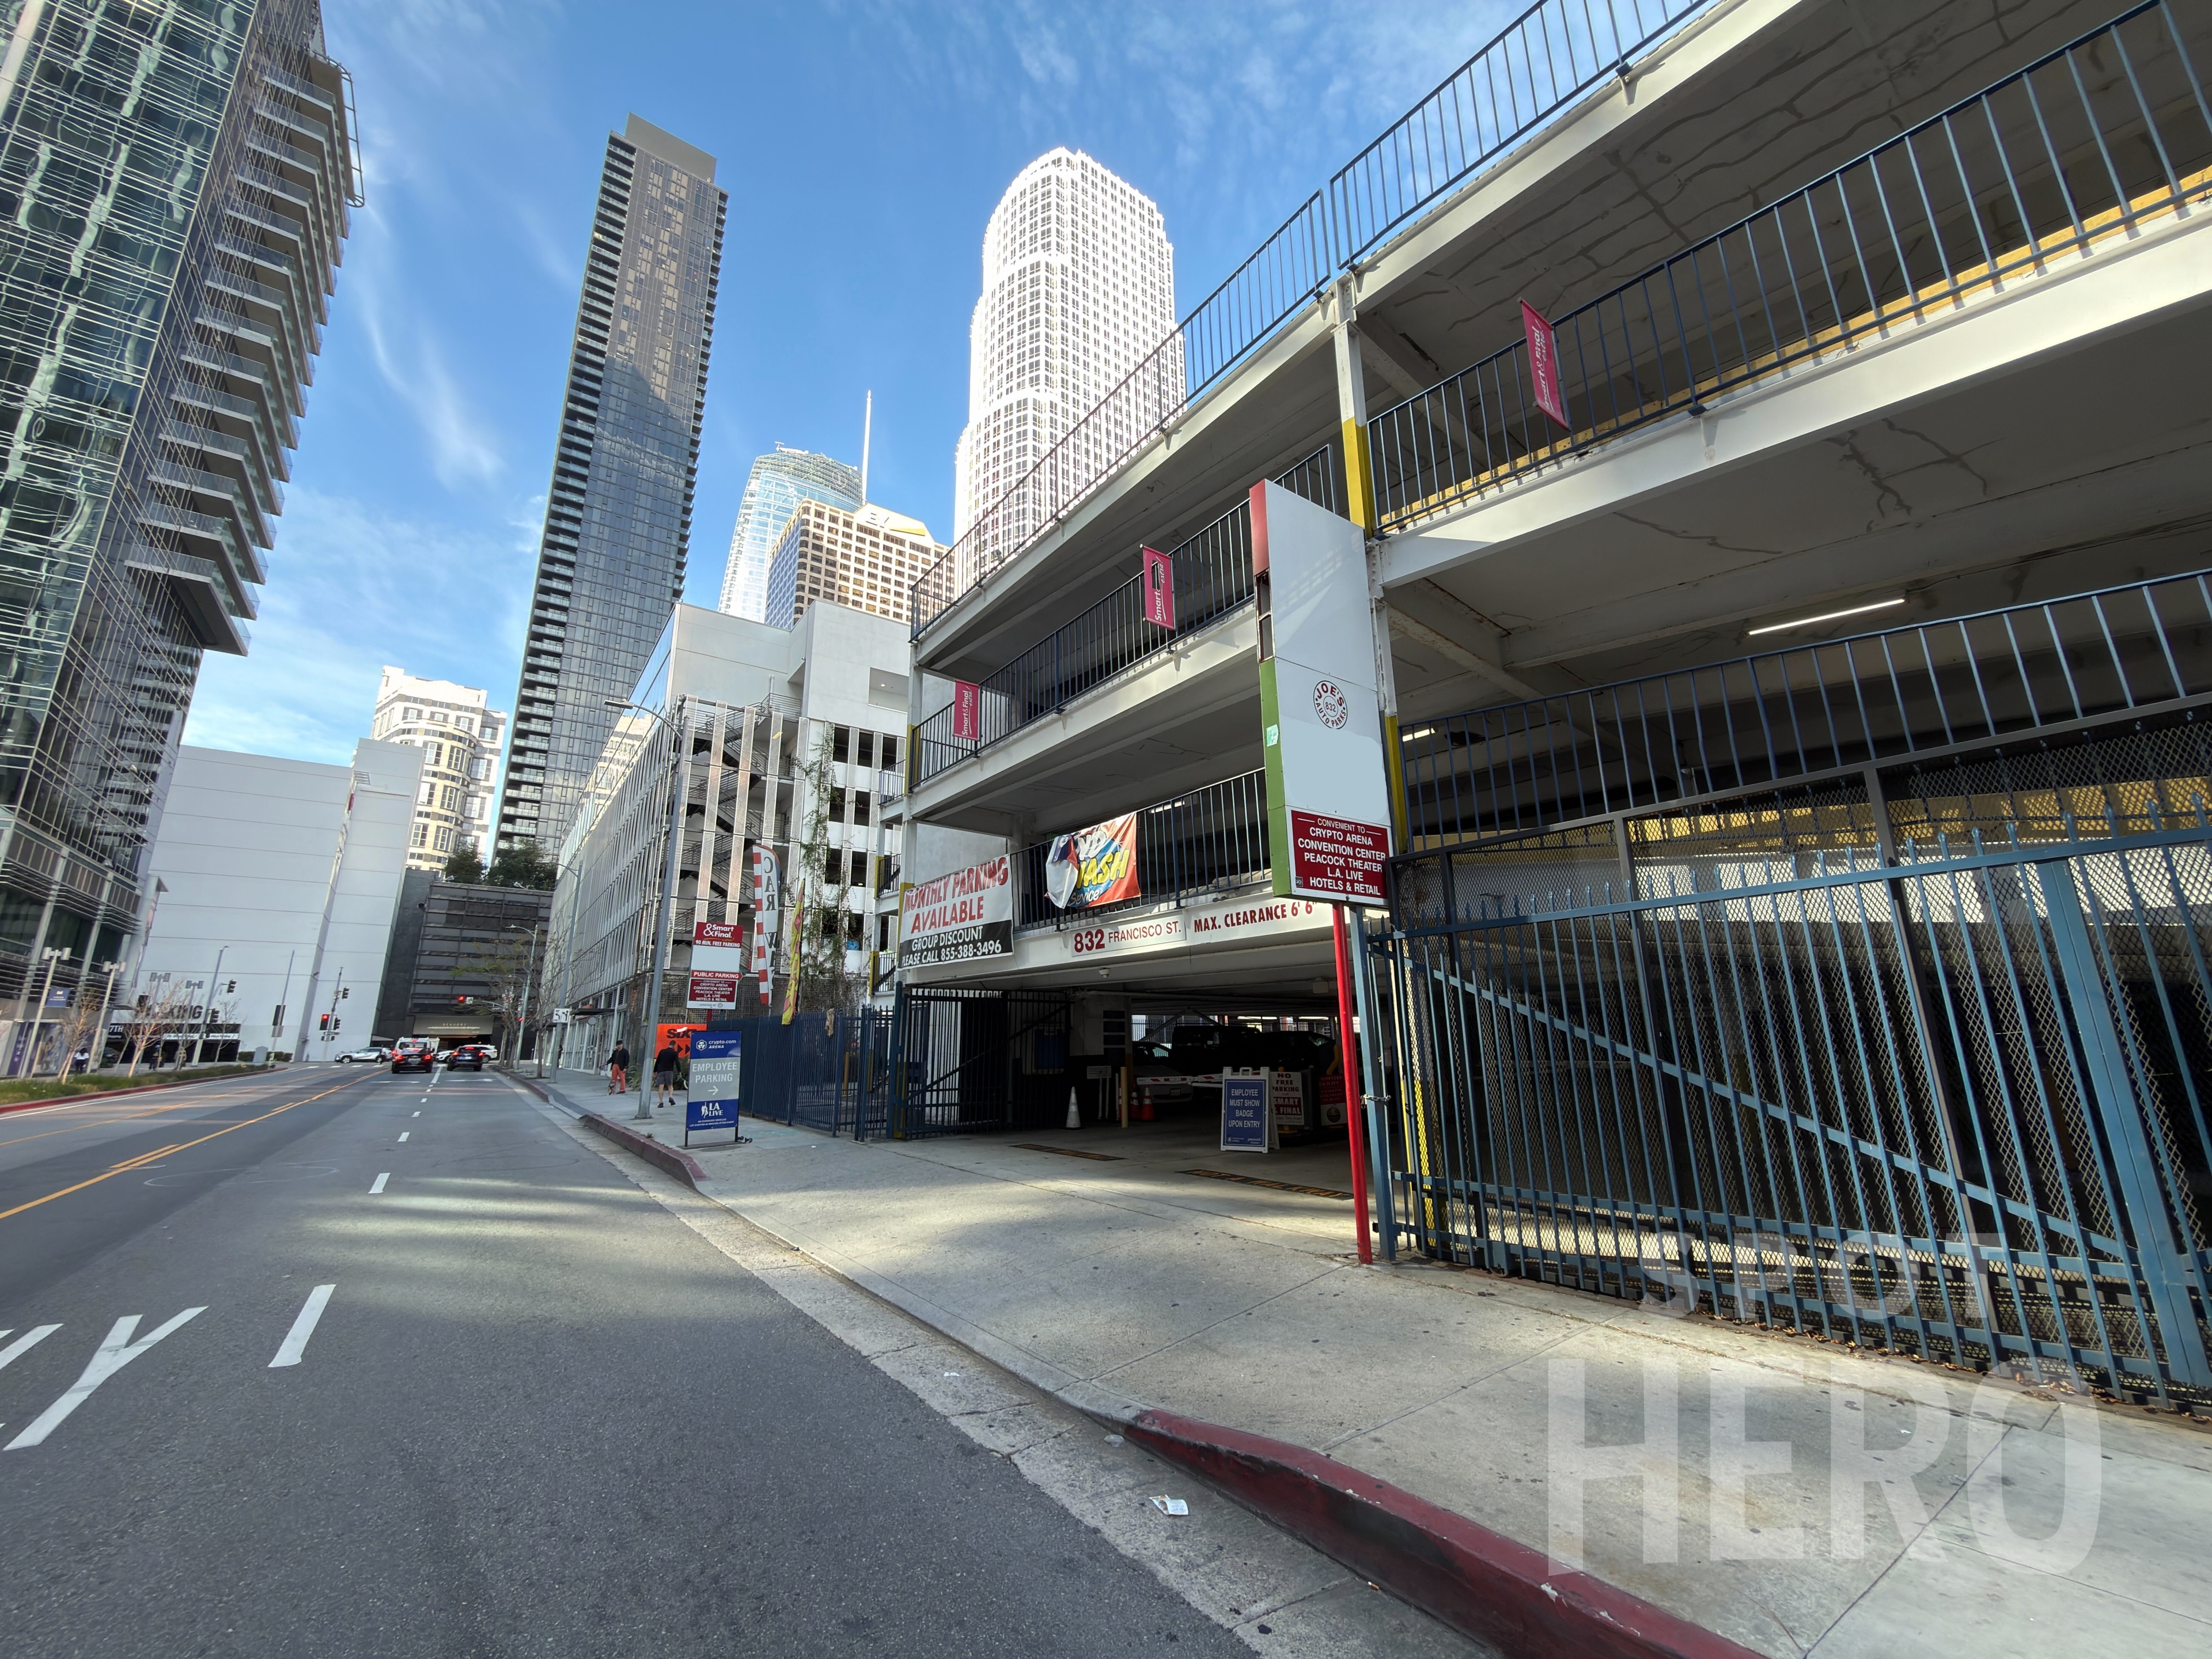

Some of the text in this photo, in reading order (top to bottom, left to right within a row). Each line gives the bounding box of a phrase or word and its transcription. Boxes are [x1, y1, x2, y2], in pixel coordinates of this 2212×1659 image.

[1316, 683, 1344, 707] JOE'S
[1316, 703, 1346, 727] AUTO PARKS
[1325, 702, 1336, 713] 832
[1317, 819, 1365, 834] CONVENIENT TO
[1309, 827, 1373, 846] CRYPTO ARENA
[1298, 838, 1386, 861] CONVENTION CENTER
[1304, 853, 1382, 872] PEACOCK THEATER
[1327, 867, 1363, 881] L.A. LIVE
[904, 857, 1009, 914] MONTHLY PARKING
[1310, 877, 1381, 895] HOTELS & RETAIL
[911, 896, 984, 934] AVAILABLE
[1194, 916, 1221, 933] MAX.
[1224, 903, 1287, 927] CLEARANCE
[1291, 901, 1301, 917] 6'
[703, 923, 714, 937] &
[912, 926, 983, 952] GROUP DISCOUNT
[1074, 921, 1181, 953] 832 FRANCISCO ST.
[902, 939, 1002, 967] PLEASE CALL 855-388-3496
[692, 1062, 737, 1072] EMPLOYEE
[695, 1073, 733, 1084] PARKING
[709, 1102, 720, 1111] LA
